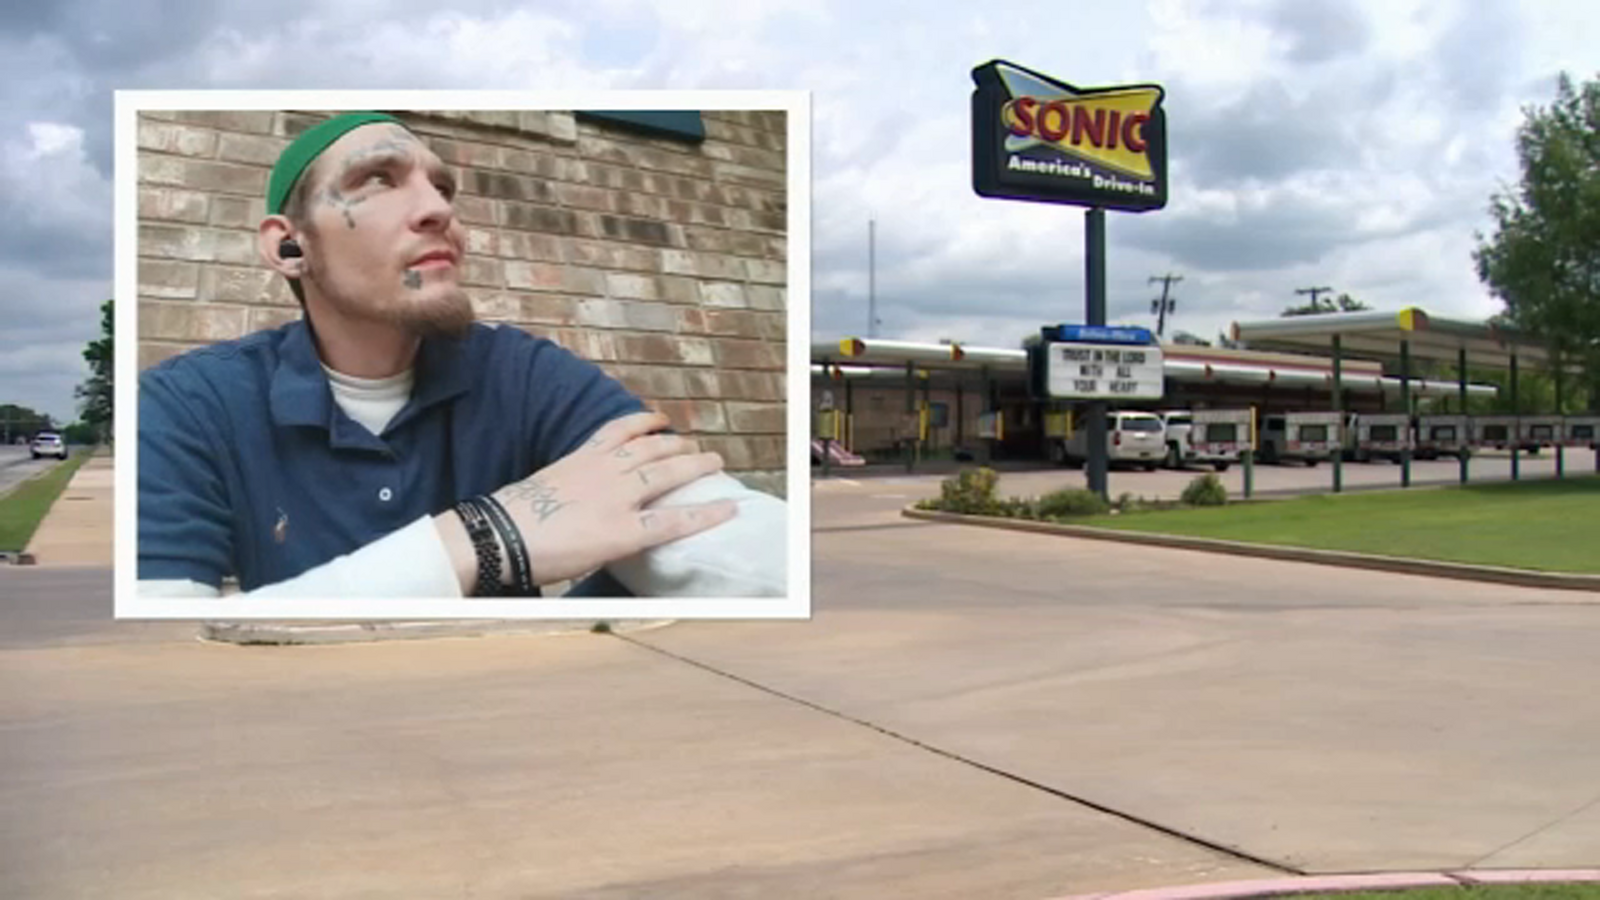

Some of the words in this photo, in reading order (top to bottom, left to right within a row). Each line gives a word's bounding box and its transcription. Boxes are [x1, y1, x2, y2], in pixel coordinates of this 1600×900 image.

[1009, 96, 1151, 153] SONIC
[1008, 155, 1091, 178] America's
[1093, 174, 1155, 195] Drive-In
[1062, 348, 1091, 361] TRUST
[1093, 349, 1103, 361] IN
[1104, 350, 1120, 363] THE
[1122, 352, 1145, 364] LORD
[1080, 365, 1103, 377] WITH
[1116, 366, 1131, 378] ALL
[1073, 380, 1097, 392] YOUR
